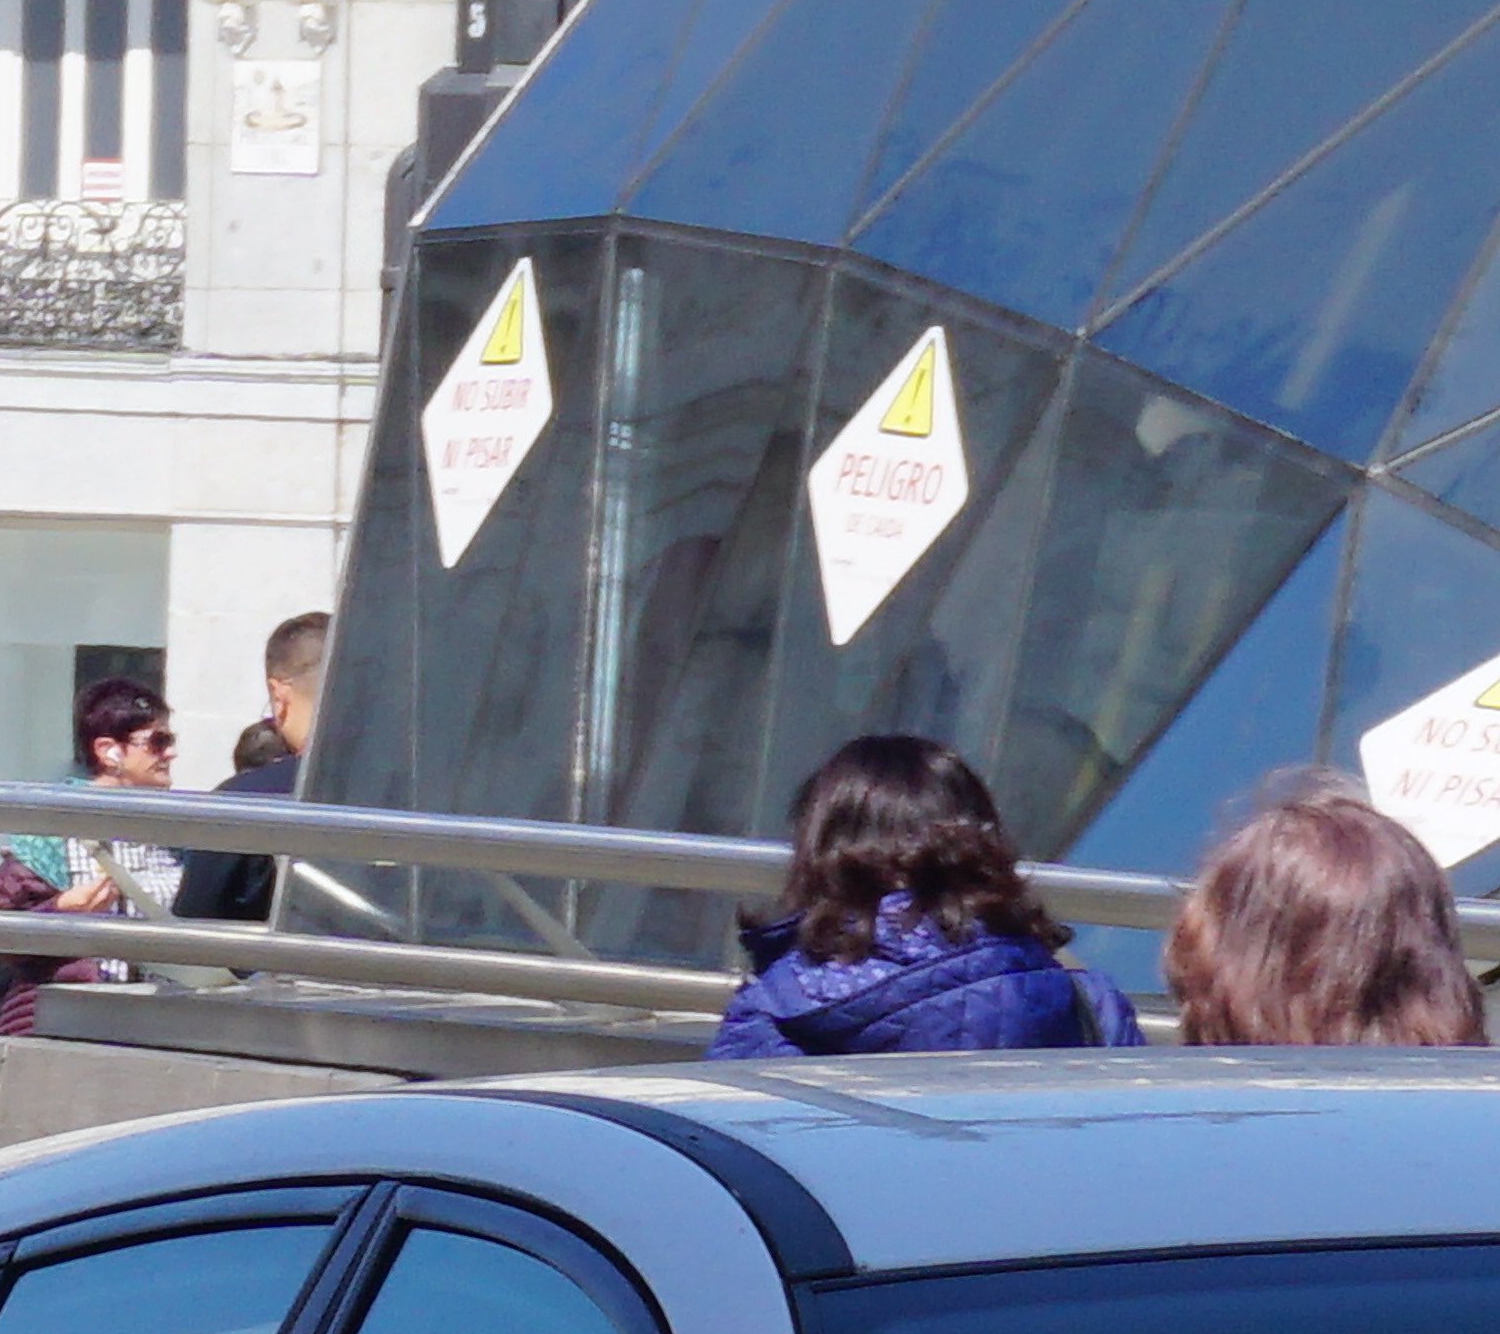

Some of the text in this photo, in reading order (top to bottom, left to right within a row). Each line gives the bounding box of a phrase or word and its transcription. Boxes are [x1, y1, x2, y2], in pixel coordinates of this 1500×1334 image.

[452, 378, 532, 412] NO SUBIR
[441, 435, 514, 469] NI PISAR
[835, 453, 944, 505] PELIGRO
[1413, 717, 1469, 749] NO
[1388, 768, 1435, 800] NI
